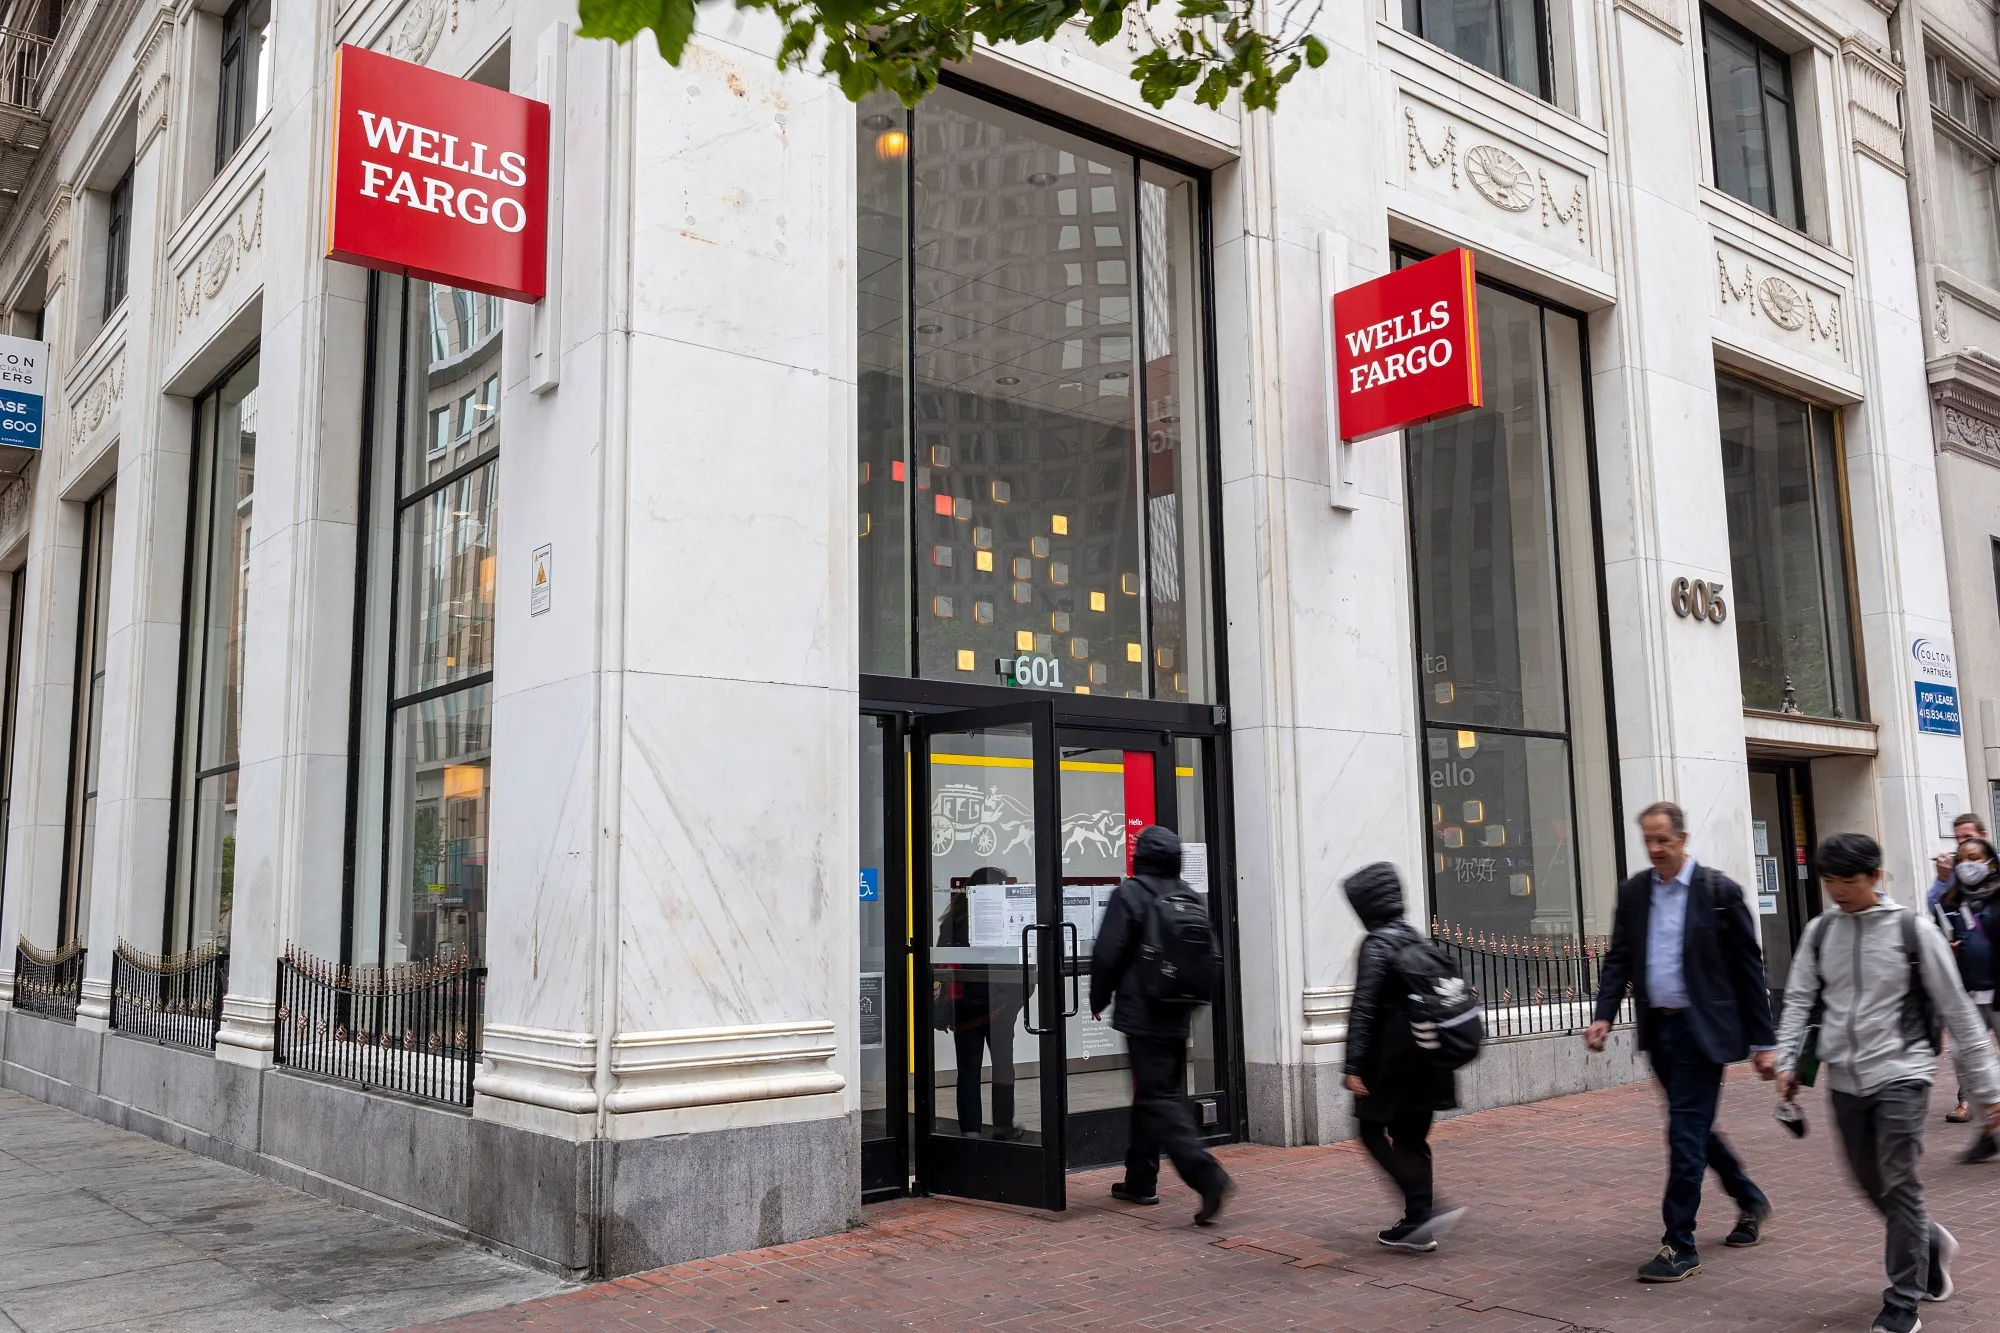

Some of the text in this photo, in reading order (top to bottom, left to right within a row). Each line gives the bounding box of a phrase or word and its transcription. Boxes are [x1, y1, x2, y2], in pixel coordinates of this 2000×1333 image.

[358, 110, 526, 187] WELLS
[359, 160, 526, 233] FARGO
[1345, 301, 1450, 357] WELLS
[1350, 339, 1453, 393] FARGO
[2, 419, 37, 433] 600
[1671, 576, 1727, 624] 605
[1920, 650, 1951, 663] COLTON
[1016, 655, 1063, 687] 601
[1922, 667, 1952, 678] PARTNERS
[1921, 691, 1954, 706] FOR LEASE
[1919, 708, 1959, 722] 415.834.1600
[1128, 818, 1143, 826] Hello
[1454, 857, 1498, 884] 你好
